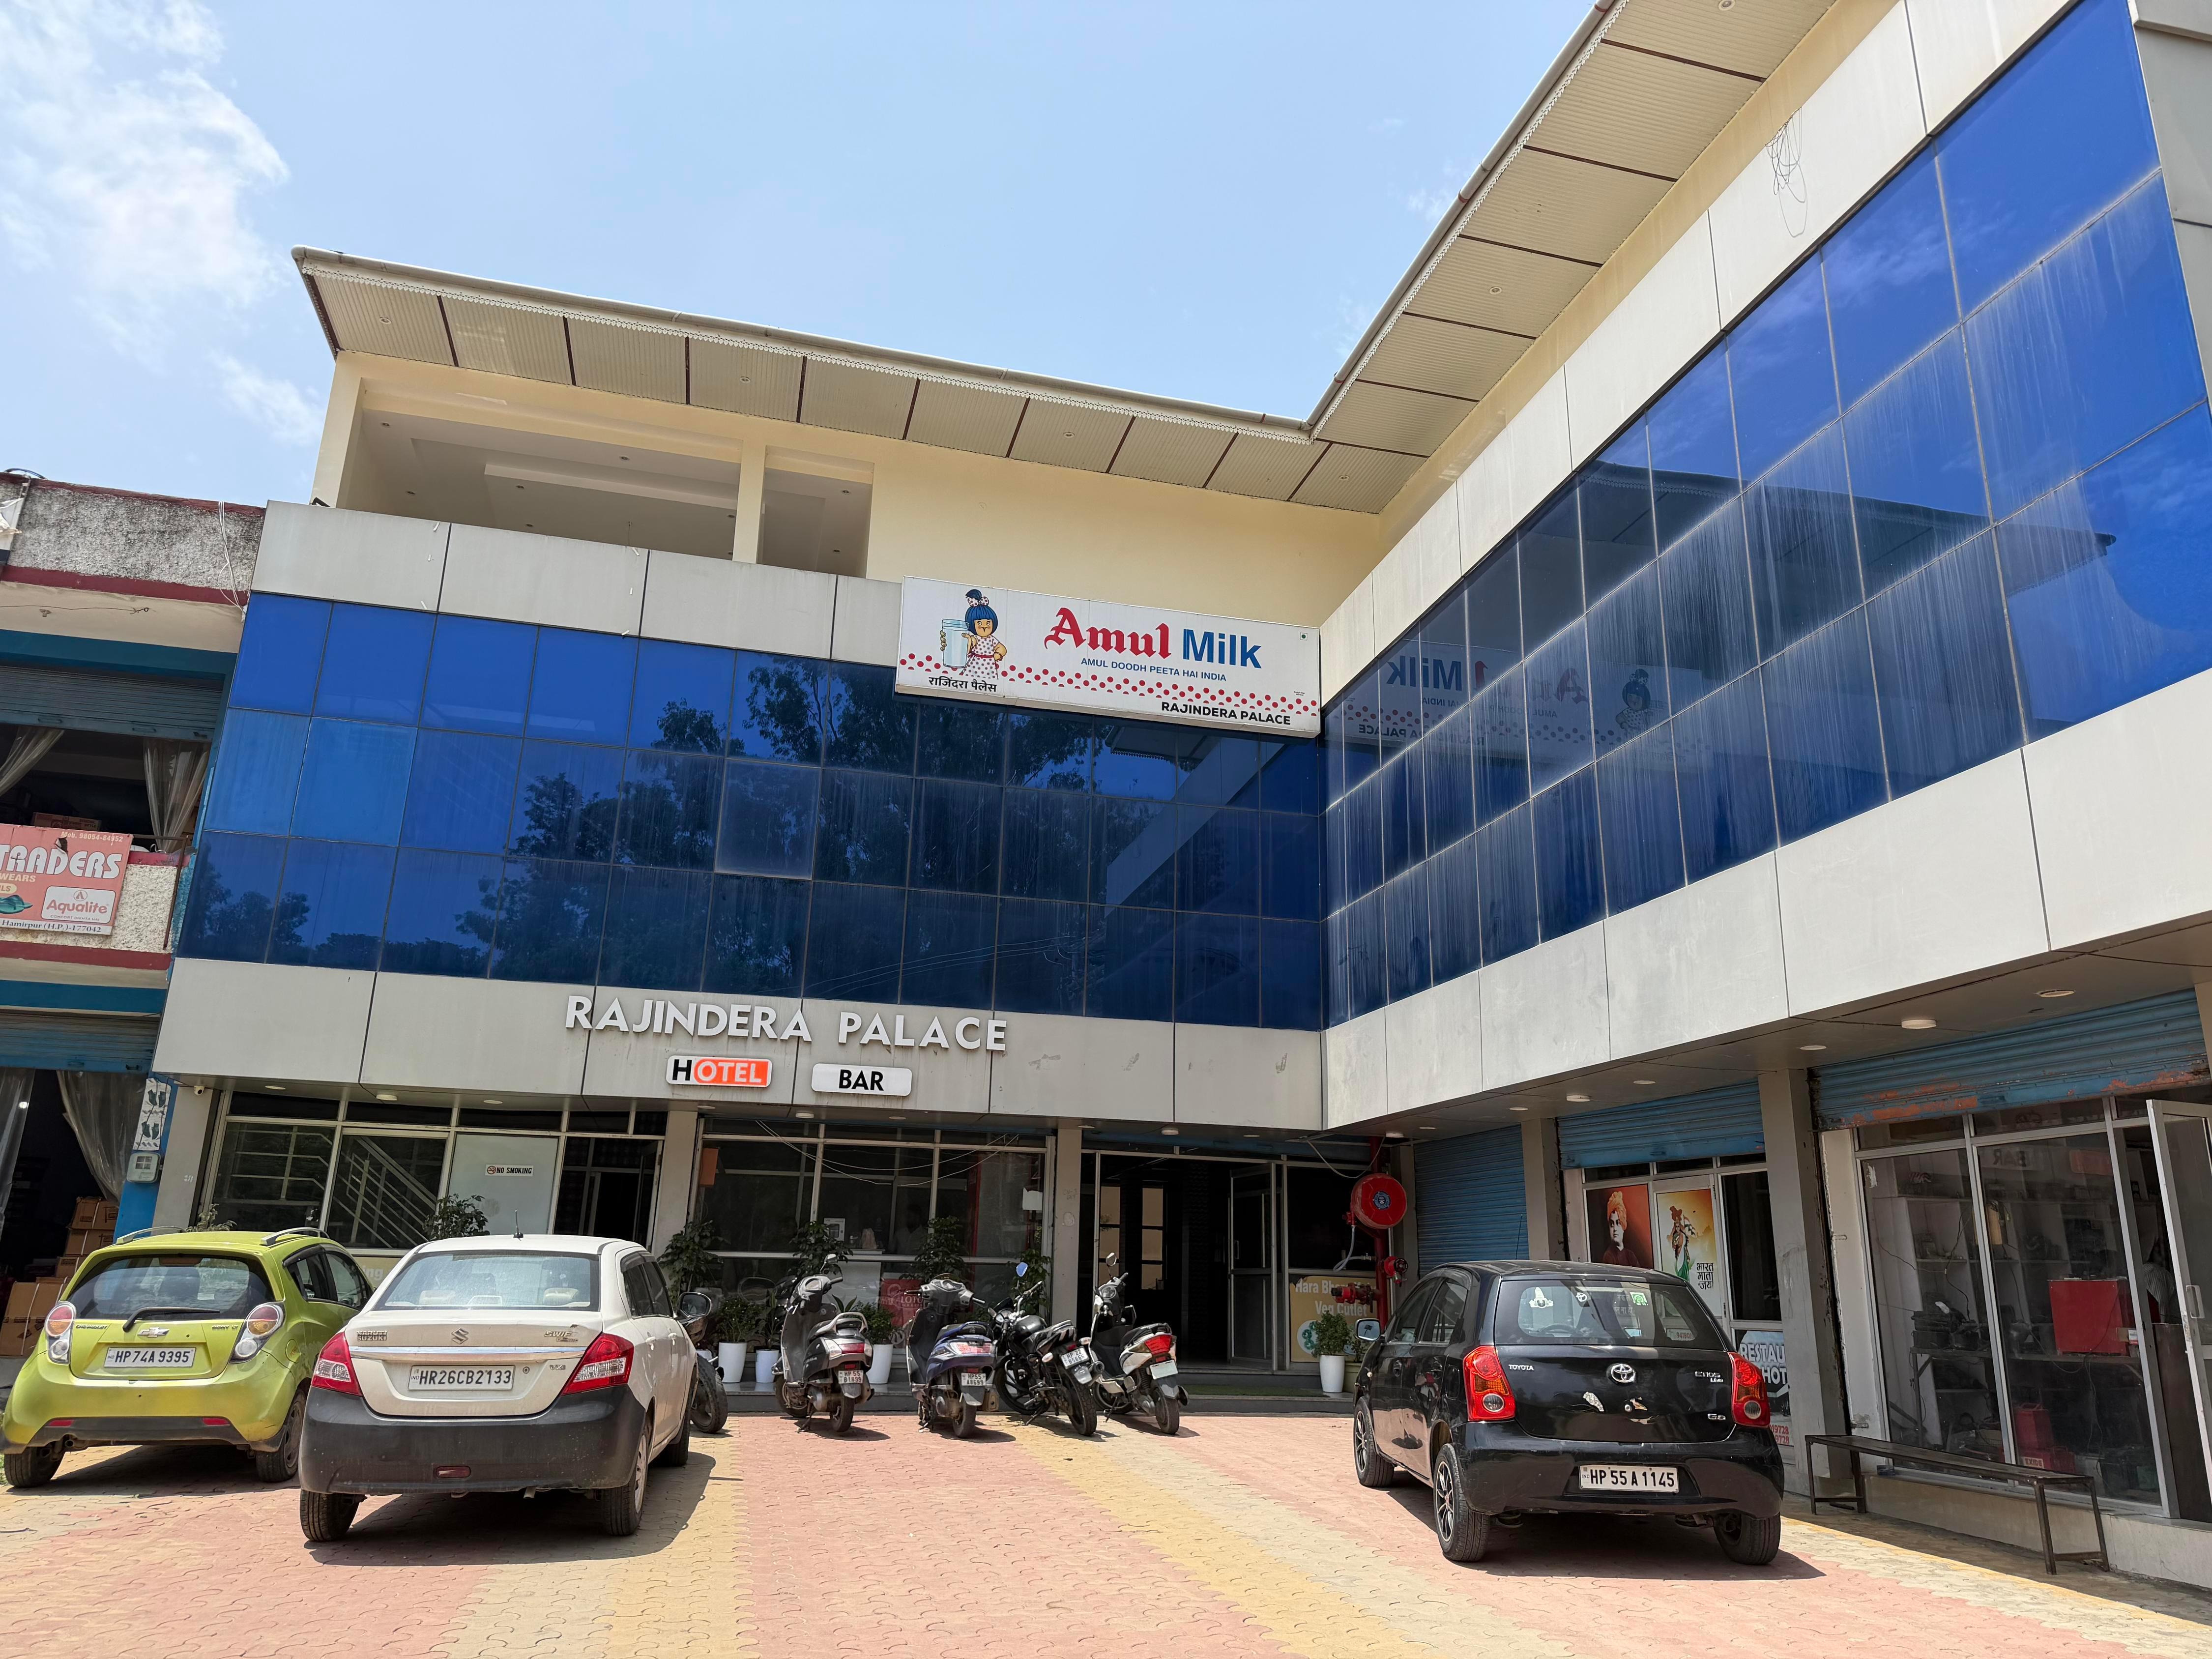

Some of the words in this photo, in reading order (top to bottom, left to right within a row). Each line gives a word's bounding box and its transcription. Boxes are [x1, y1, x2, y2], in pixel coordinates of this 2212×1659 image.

[1044, 608, 1171, 659] Amul
[1183, 629, 1262, 669] Milk
[1081, 658, 1108, 668] AMUL
[1111, 661, 1146, 672] DOODH
[1150, 666, 1179, 676] PEETA
[1182, 669, 1198, 678] HAI
[1201, 671, 1226, 682] INDIA
[929, 676, 968, 689] राजिंदरा
[971, 678, 997, 692] पैलेस
[1162, 701, 1237, 719] RAJINDERA
[1241, 710, 1290, 725] PALACE
[47, 900, 108, 914] Aqualite
[2, 920, 42, 930] Hamirpur
[44, 920, 101, 932] (H.P.)-177042
[566, 995, 812, 1043] RAJINDERA
[839, 1011, 1007, 1051] PALACE
[672, 1058, 762, 1084] HOTEL
[839, 1069, 884, 1091] BAR
[1696, 1262, 1714, 1271] भारत
[1295, 1278, 1319, 1293] Hara
[1696, 1272, 1714, 1285] माता
[1337, 1303, 1368, 1317] Cutlet
[115, 1351, 130, 1363] HP
[132, 1351, 155, 1363] 74A
[158, 1351, 190, 1363] 9395
[419, 1370, 512, 1384] HR26CB2133
[1590, 1469, 1606, 1484] HP
[1610, 1470, 1627, 1485] 55
[1631, 1471, 1638, 1486] A
[1642, 1471, 1674, 1487] 1145
